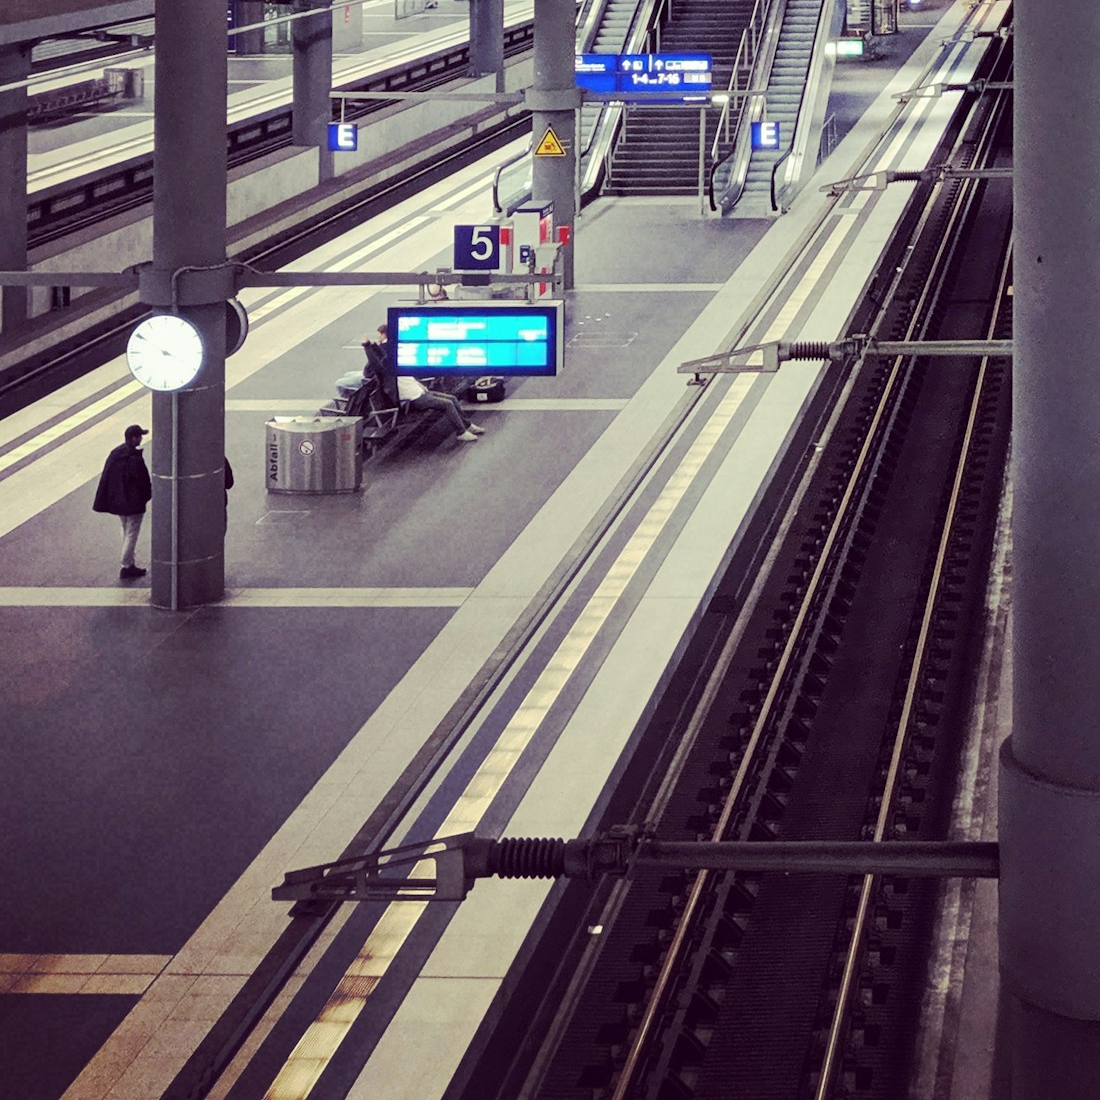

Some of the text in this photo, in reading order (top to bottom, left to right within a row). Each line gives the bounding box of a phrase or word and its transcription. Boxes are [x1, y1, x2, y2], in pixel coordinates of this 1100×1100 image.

[338, 125, 354, 146] E
[761, 122, 776, 145] E
[471, 227, 493, 260] 5
[269, 444, 279, 481] Abfall
